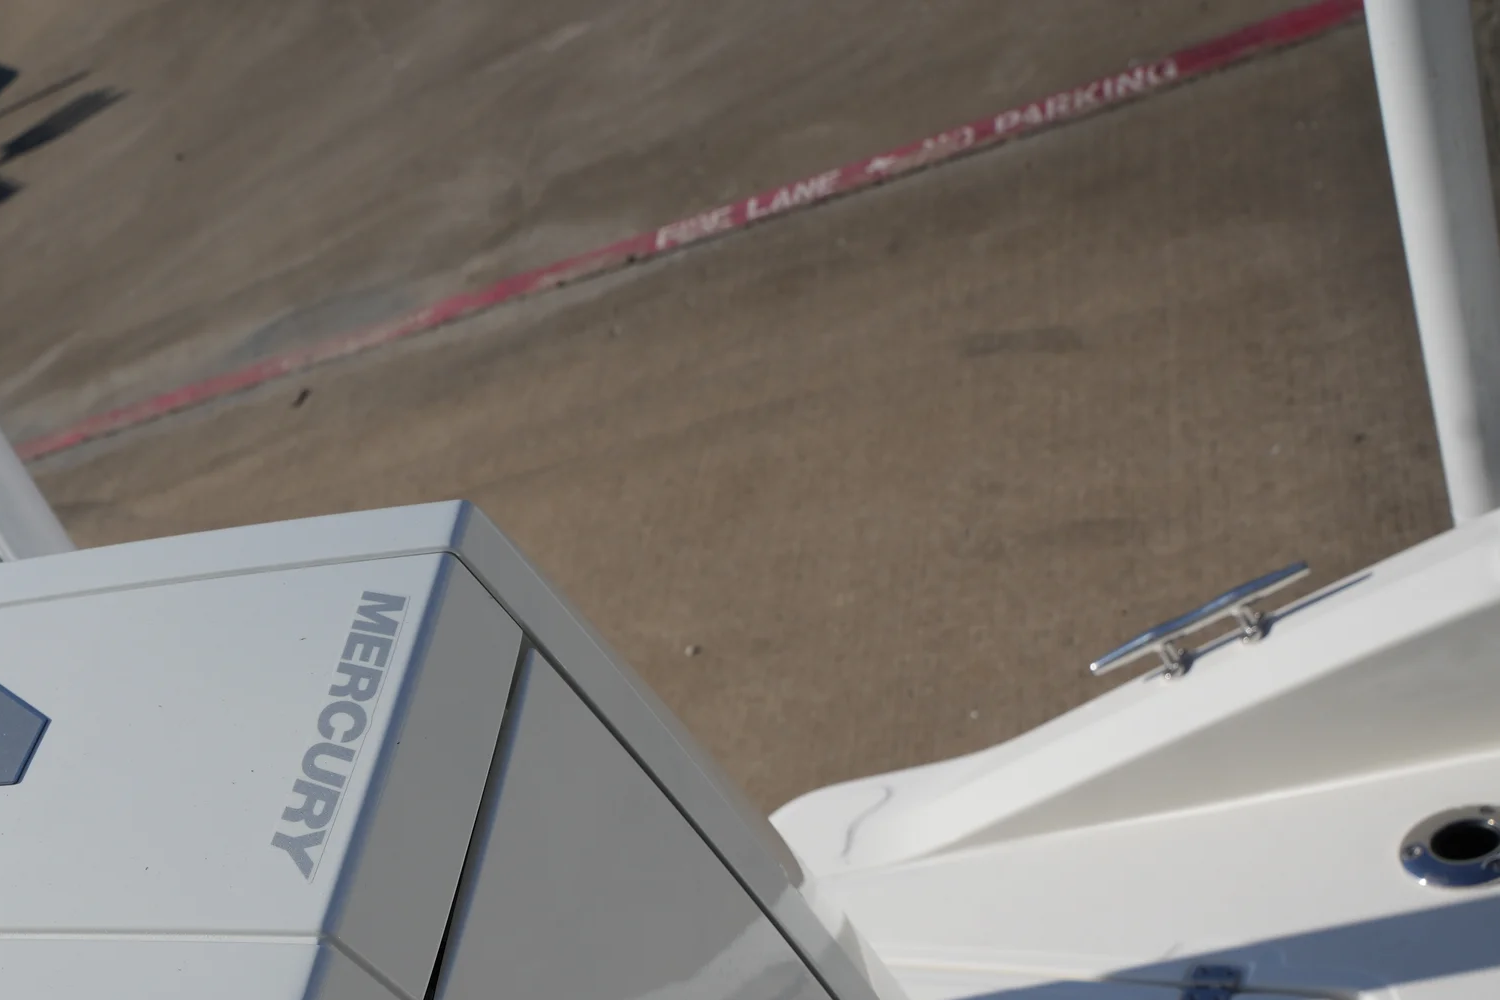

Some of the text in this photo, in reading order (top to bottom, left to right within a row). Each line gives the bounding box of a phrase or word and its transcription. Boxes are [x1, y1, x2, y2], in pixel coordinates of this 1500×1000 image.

[746, 169, 841, 219] LANE
[995, 58, 1178, 133] PARKING
[271, 591, 406, 879] MERCURY
